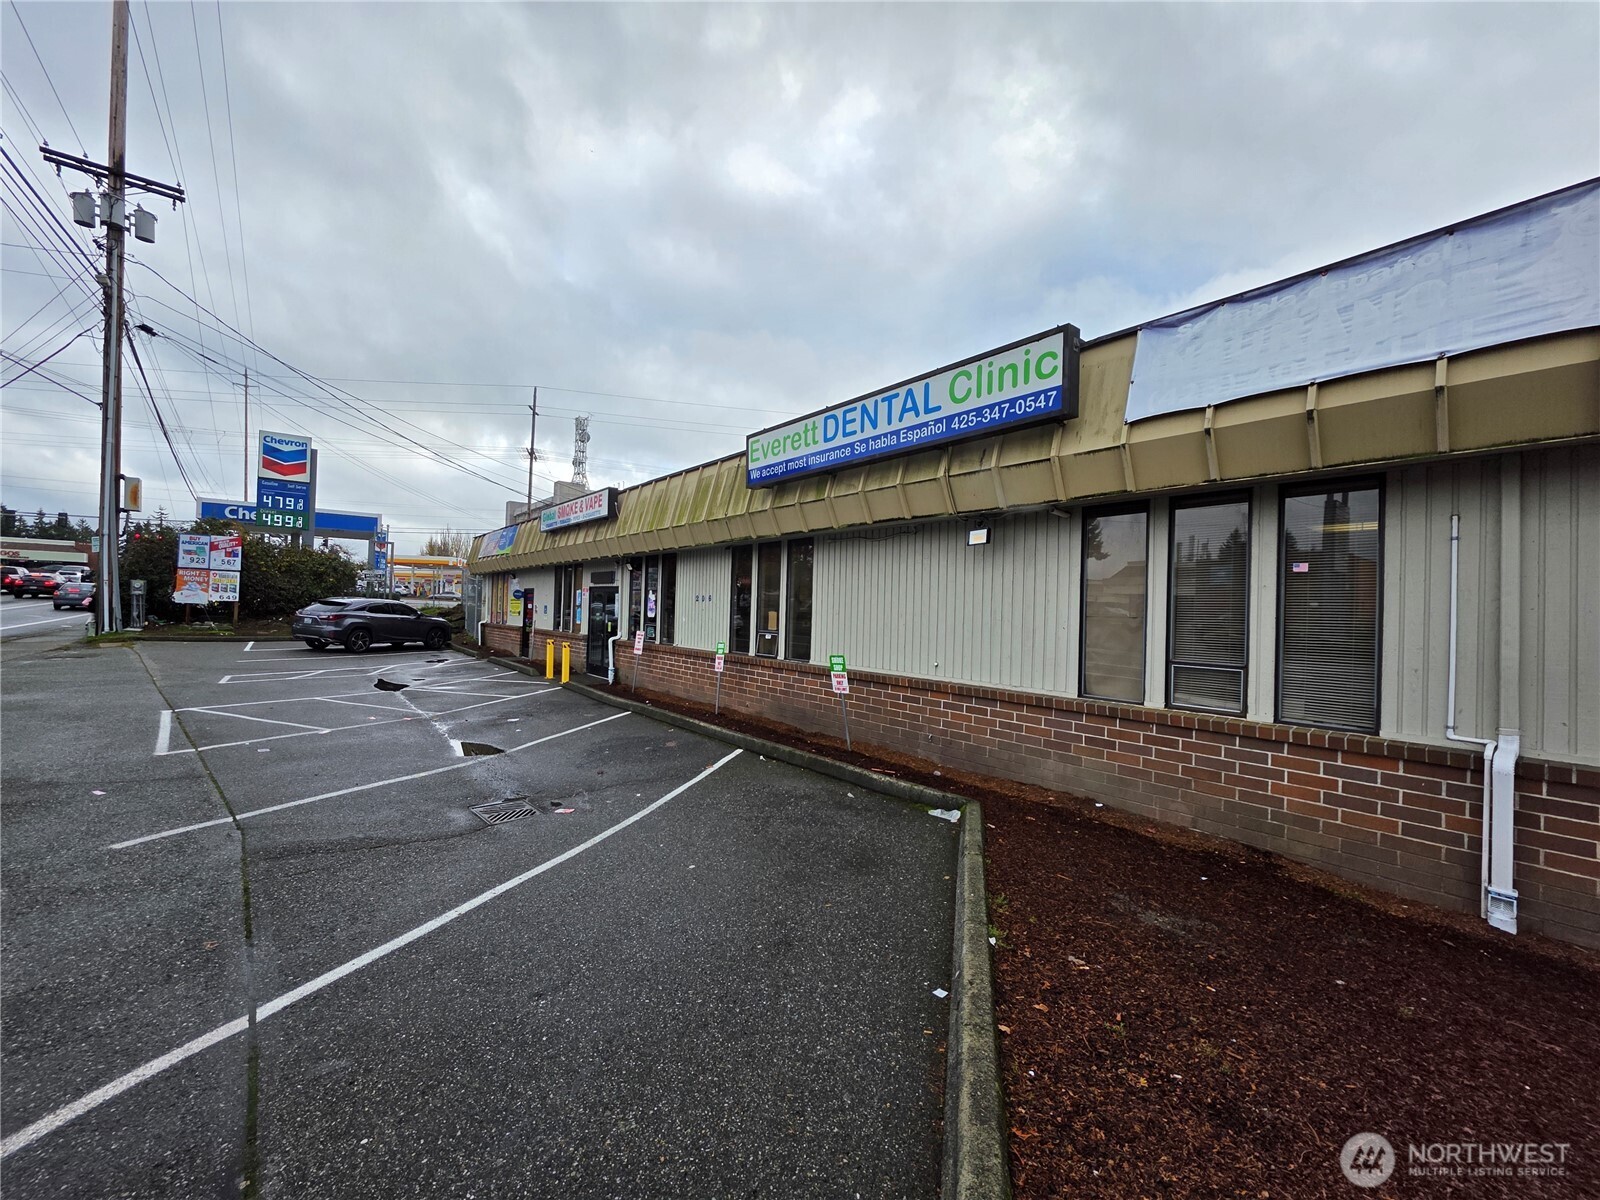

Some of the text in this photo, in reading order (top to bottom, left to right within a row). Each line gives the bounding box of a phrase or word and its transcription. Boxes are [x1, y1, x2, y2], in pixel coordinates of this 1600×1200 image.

[749, 348, 1059, 463] Everett DENTAL Clinic
[263, 435, 308, 448] Chevron
[749, 390, 1058, 480] We accept most insurance Se habla Español 425-347-0547
[263, 495, 294, 509] 479
[557, 502, 579, 519] SMOKE
[579, 500, 584, 513] &
[585, 493, 603, 511] VAPE
[262, 513, 294, 527] 499
